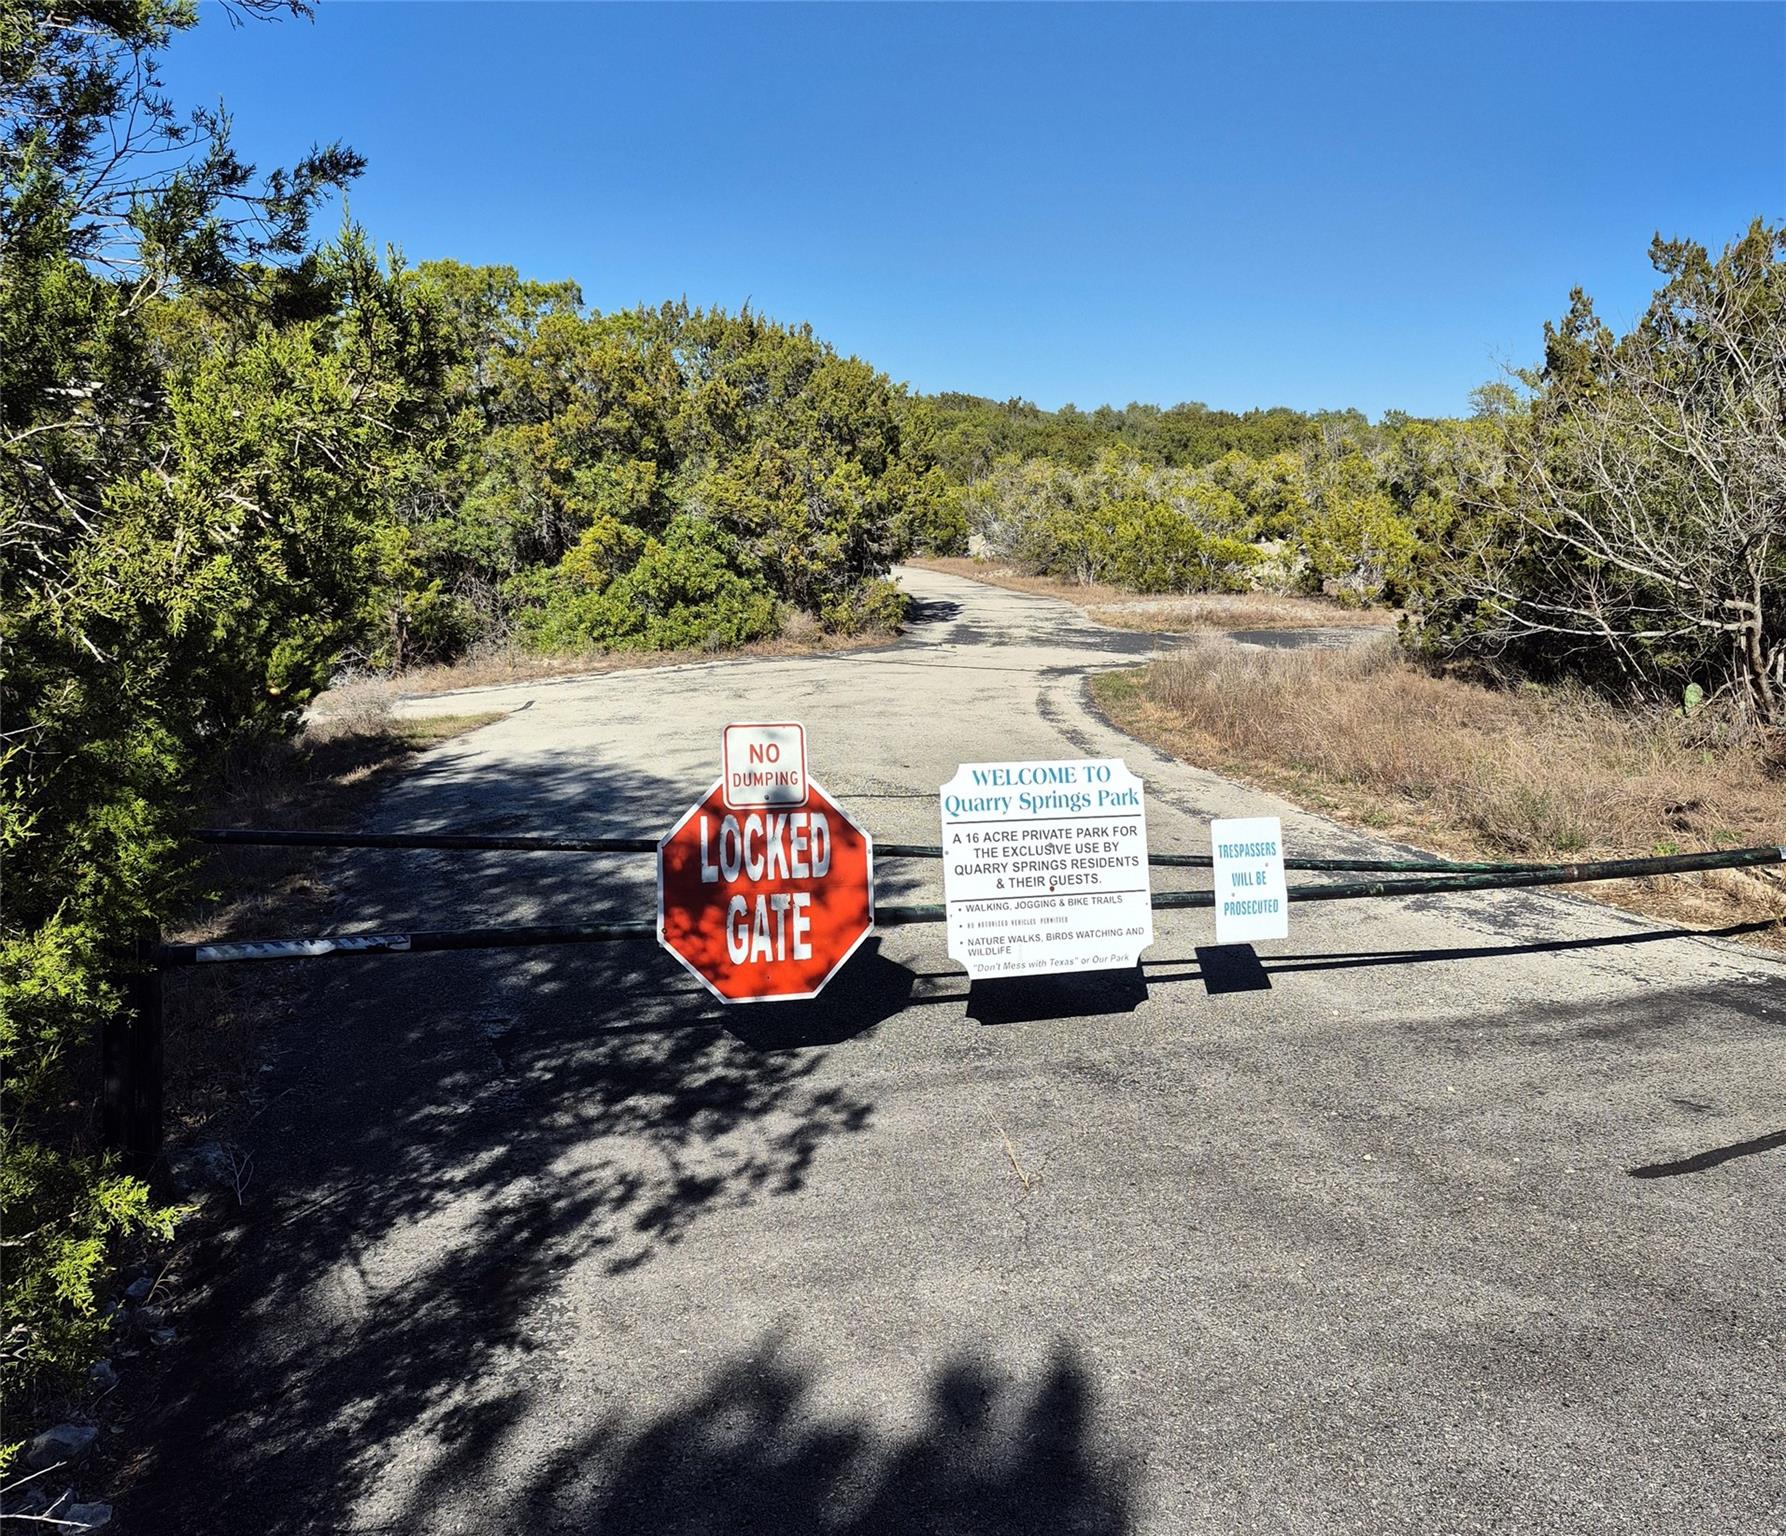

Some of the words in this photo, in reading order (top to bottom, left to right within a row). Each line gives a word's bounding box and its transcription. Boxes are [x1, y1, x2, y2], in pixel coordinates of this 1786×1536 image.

[749, 744, 780, 764] NO
[732, 771, 798, 787] DUMPING
[972, 766, 1077, 786] WELCOME
[1083, 765, 1111, 783] TO
[945, 795, 1012, 817] Quarry
[1019, 791, 1091, 813] Springs
[1098, 788, 1139, 806] Park
[953, 834, 961, 843] A
[966, 833, 979, 843] 16
[984, 831, 1018, 842] ACRE
[1022, 829, 1072, 840] PRIVATE
[1077, 827, 1109, 838] PARK
[1113, 826, 1137, 836] FOR
[700, 812, 831, 884] LOCKED
[974, 848, 998, 858] THE
[1003, 844, 1071, 857] EXCLUSIVE
[1075, 843, 1099, 853] USE
[1104, 842, 1119, 852] BY
[1218, 842, 1276, 858] TRESPASSERS
[954, 863, 1008, 875] QUARRY
[1012, 859, 1067, 872] SPRINGS
[1071, 856, 1139, 869] RESIDENTS
[996, 878, 1005, 889] &
[1009, 877, 1045, 888] THEIR
[1049, 874, 1102, 886] GUESTS.
[1232, 872, 1253, 886] WILL
[1256, 871, 1266, 885] BE
[966, 902, 1013, 912] WALKING,
[1015, 900, 1056, 909] JOGGING
[1059, 899, 1065, 907] &
[1068, 898, 1089, 906] BIKE
[1091, 895, 1123, 905] TRAILS
[1224, 899, 1278, 916] PROSECUTED
[726, 892, 813, 965] GATE
[968, 936, 1006, 947] NATURE
[1008, 934, 1043, 944] WALKS,
[1046, 932, 1074, 941] BIRDS
[1076, 929, 1124, 940] WATCHING
[1126, 927, 1144, 936] AND
[968, 946, 1012, 956] WILDLIFE
[1003, 959, 1026, 970] Mess
[1028, 959, 1047, 968] with
[1081, 956, 1090, 964] or
[1092, 955, 1108, 964] Our
[1110, 953, 1129, 962] Park
